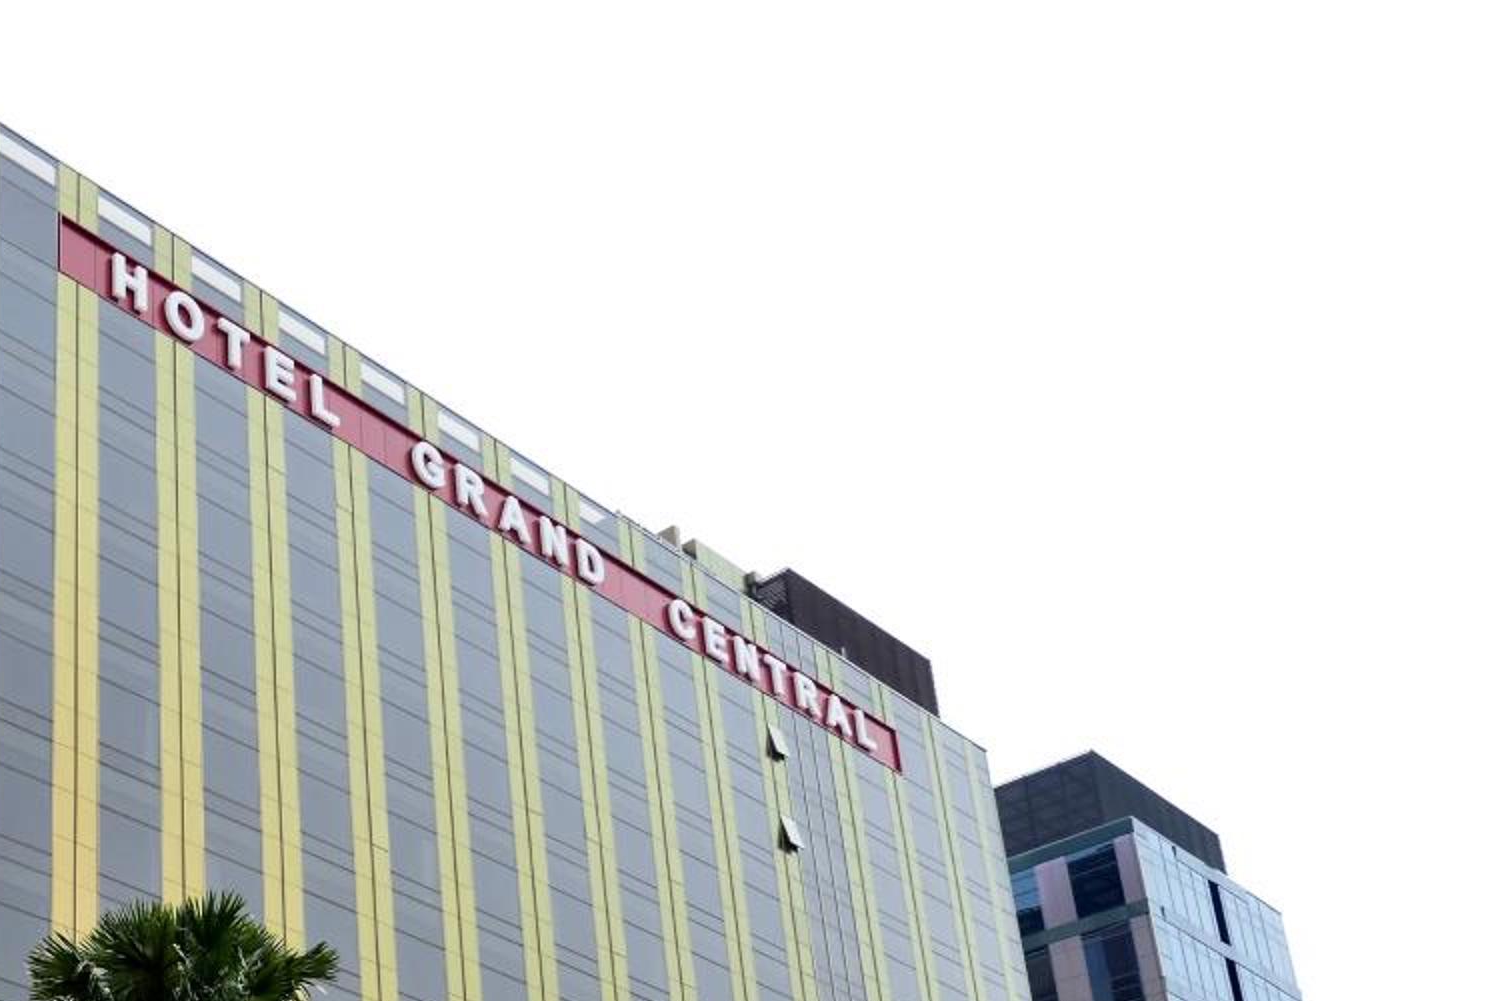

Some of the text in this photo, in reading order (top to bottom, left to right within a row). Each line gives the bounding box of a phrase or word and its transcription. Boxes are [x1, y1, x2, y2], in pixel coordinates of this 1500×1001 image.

[110, 251, 878, 751] HOTEL GRAND CENTRAL
